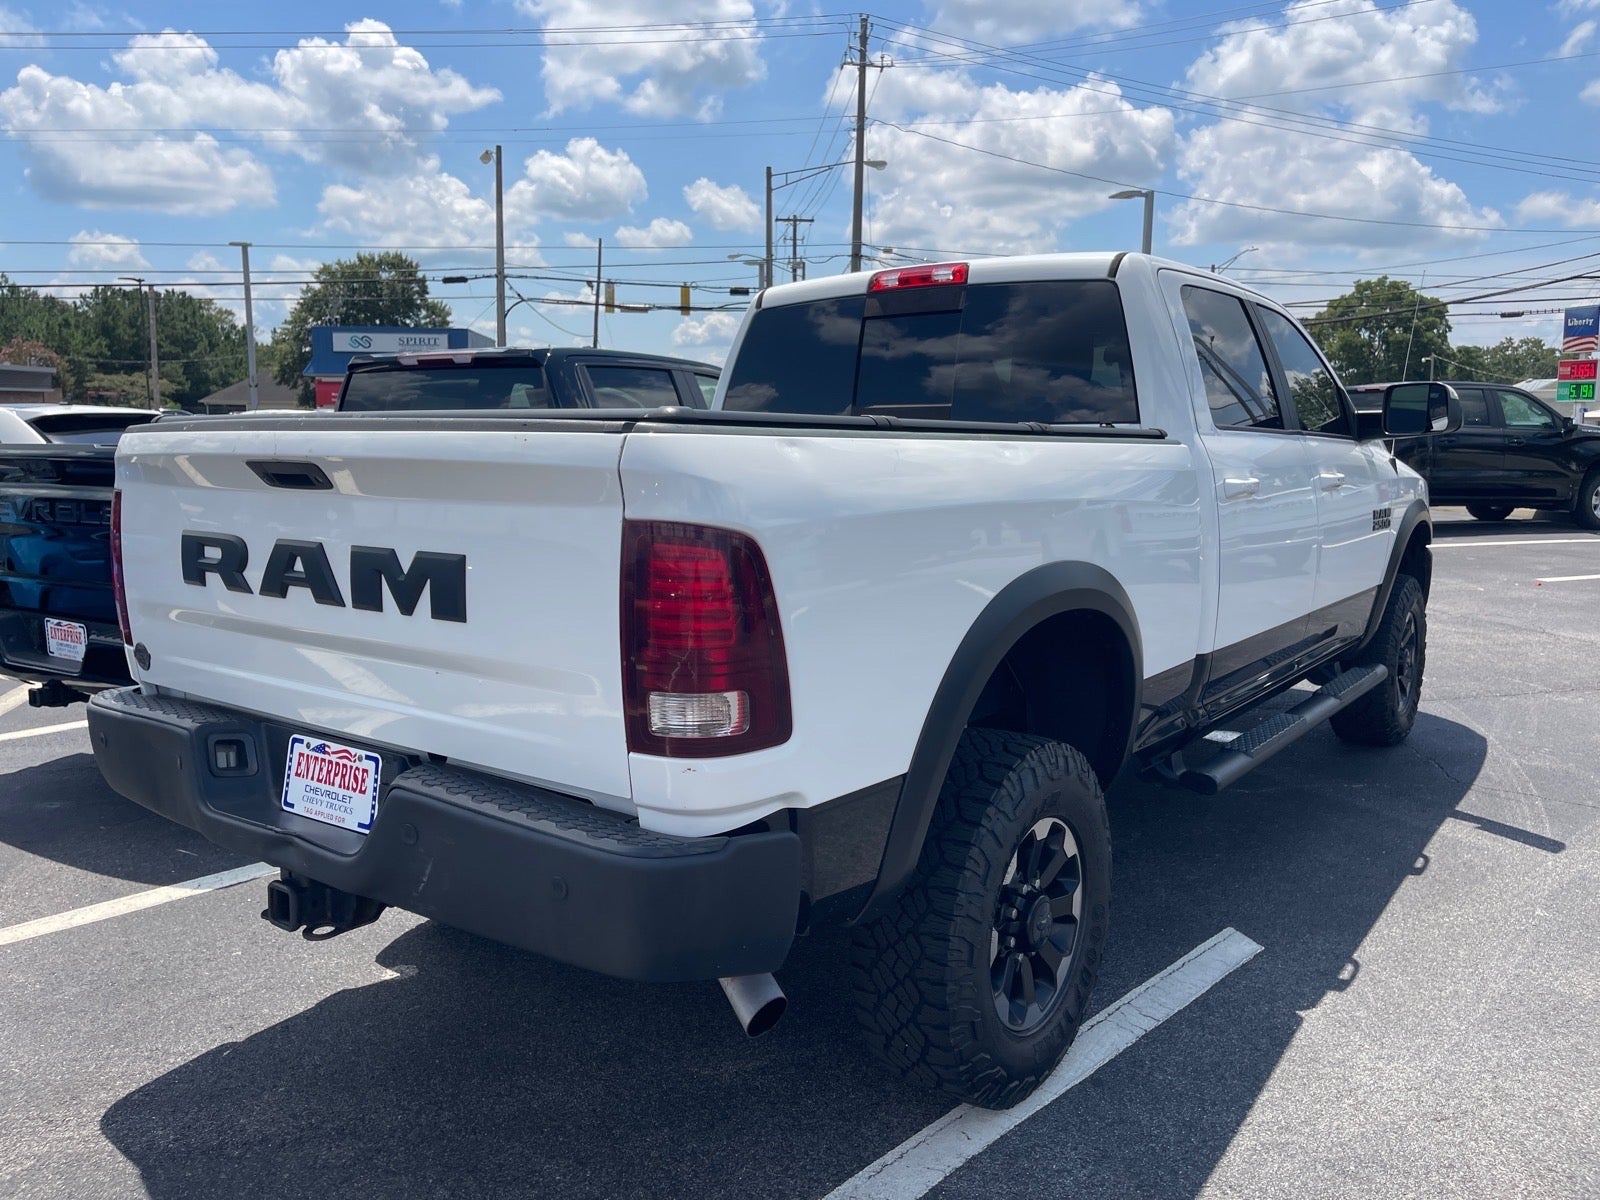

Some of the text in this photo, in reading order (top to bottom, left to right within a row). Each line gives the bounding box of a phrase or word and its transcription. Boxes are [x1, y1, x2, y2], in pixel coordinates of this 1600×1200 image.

[398, 336, 440, 346] SPIRIT
[181, 529, 467, 623] RAM
[294, 751, 369, 795] ENTERPRISE
[301, 794, 354, 815] CHEVY TRUCKS
[304, 784, 353, 805] CHEVROLET
[303, 806, 346, 824] TAG APPLIED FOR
